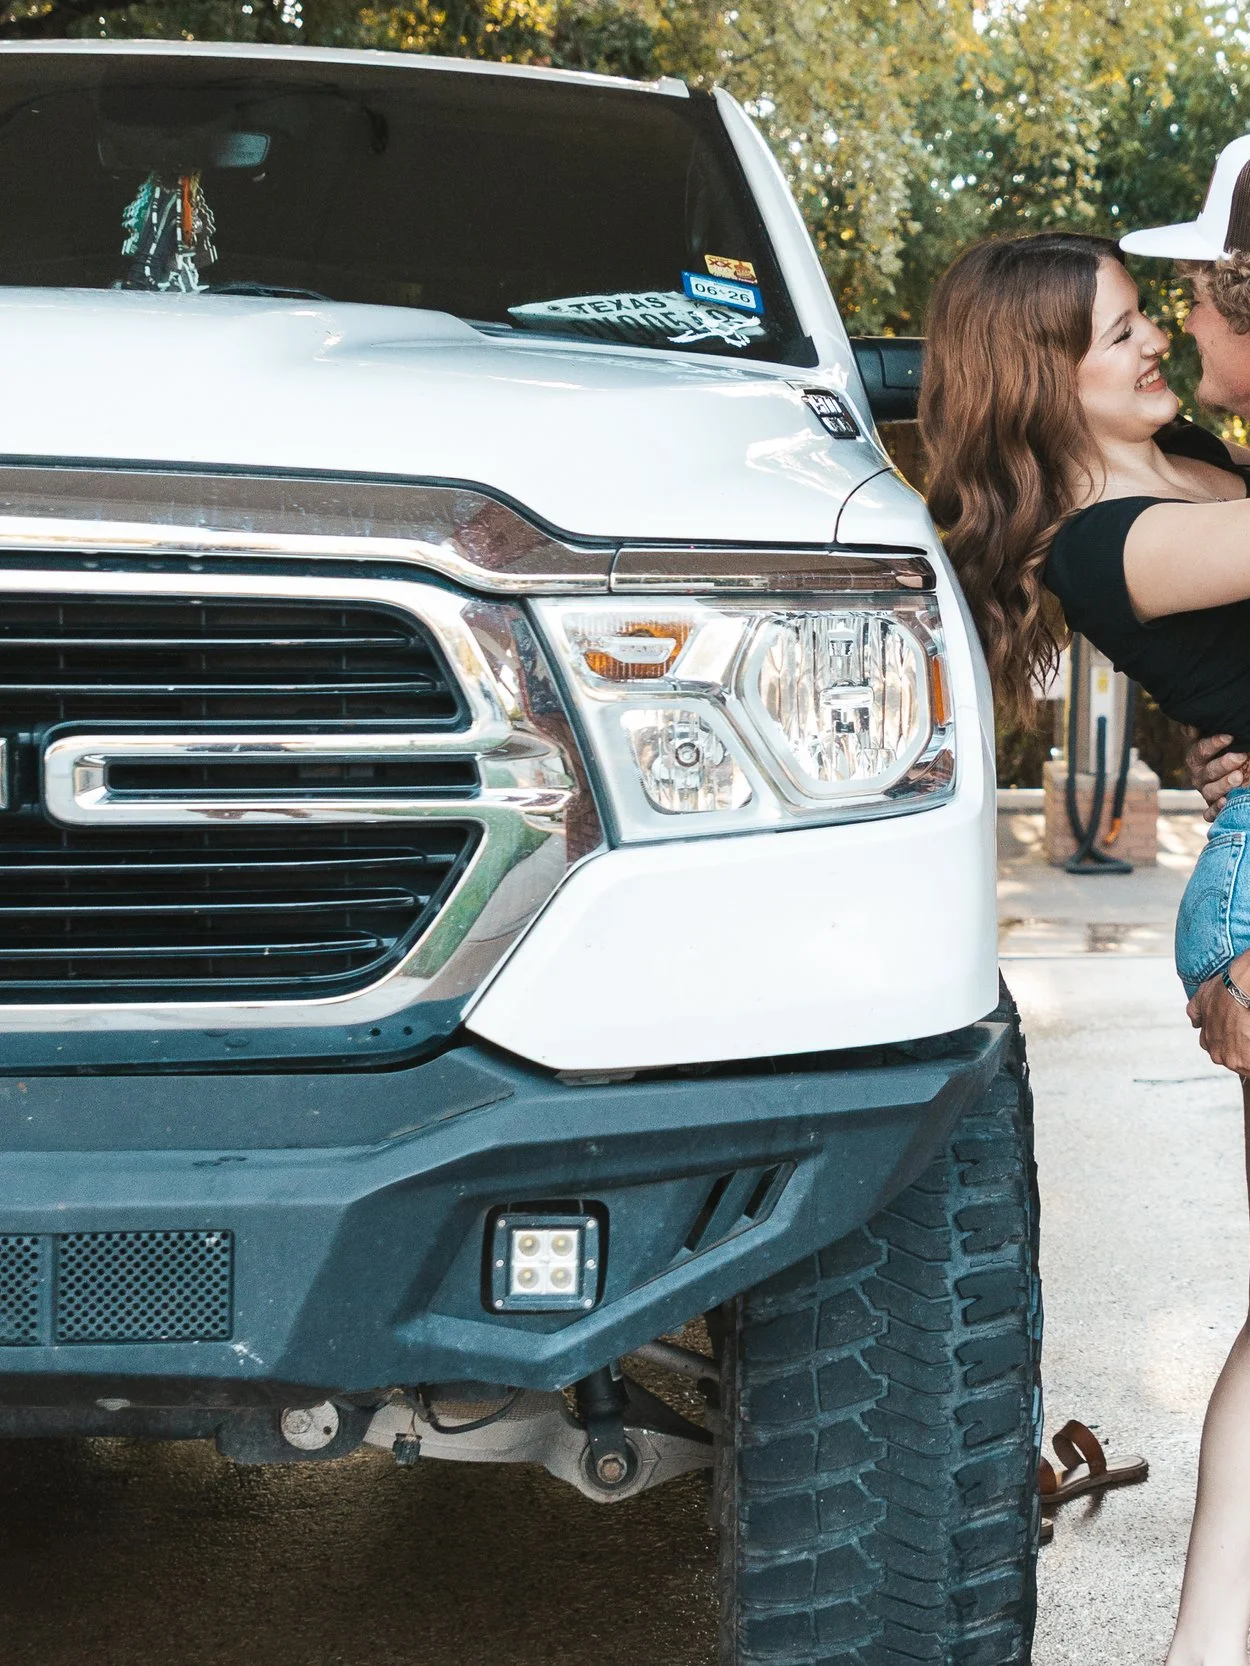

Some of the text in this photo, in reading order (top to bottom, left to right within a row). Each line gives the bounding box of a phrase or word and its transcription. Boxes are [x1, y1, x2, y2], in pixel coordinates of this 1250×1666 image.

[695, 283, 750, 303] 06 26
[568, 296, 667, 314] TEXAS
